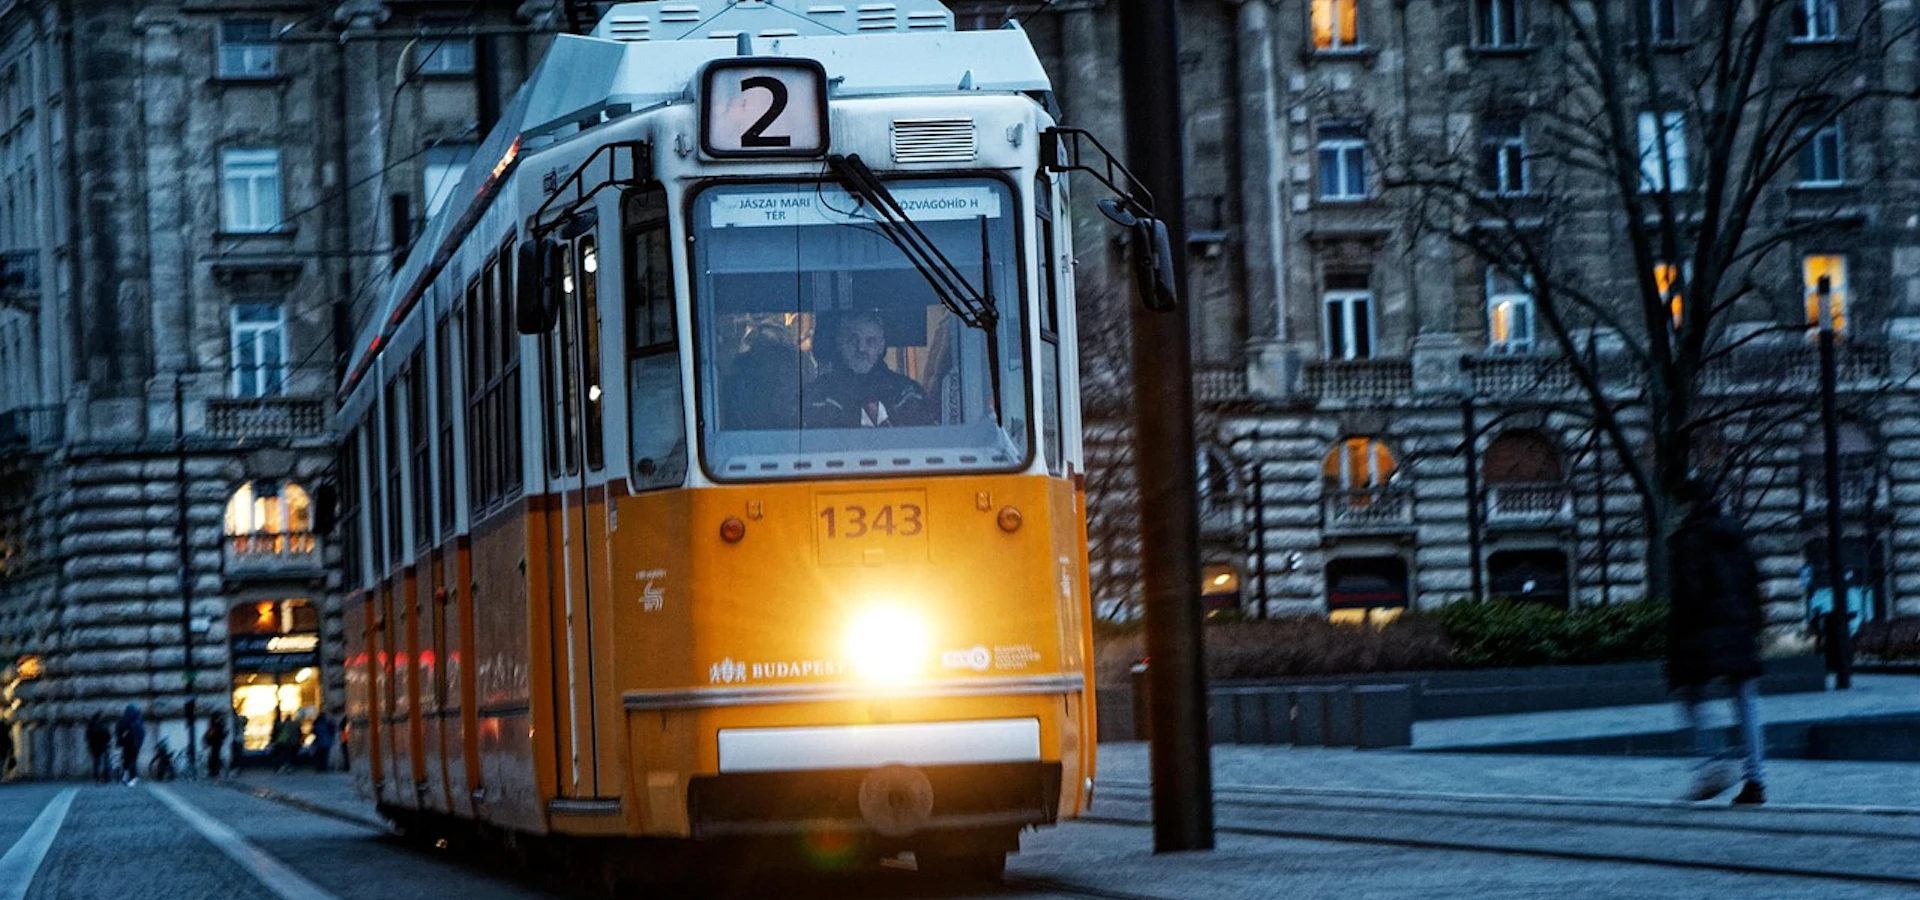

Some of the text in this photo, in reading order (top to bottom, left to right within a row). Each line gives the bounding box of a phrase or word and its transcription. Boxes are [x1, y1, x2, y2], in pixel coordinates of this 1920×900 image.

[741, 76, 791, 147] 2
[740, 198, 811, 209] JÁSZAI MARI
[970, 199, 979, 208] H
[765, 210, 786, 220] TÉR
[820, 504, 923, 538] 1343
